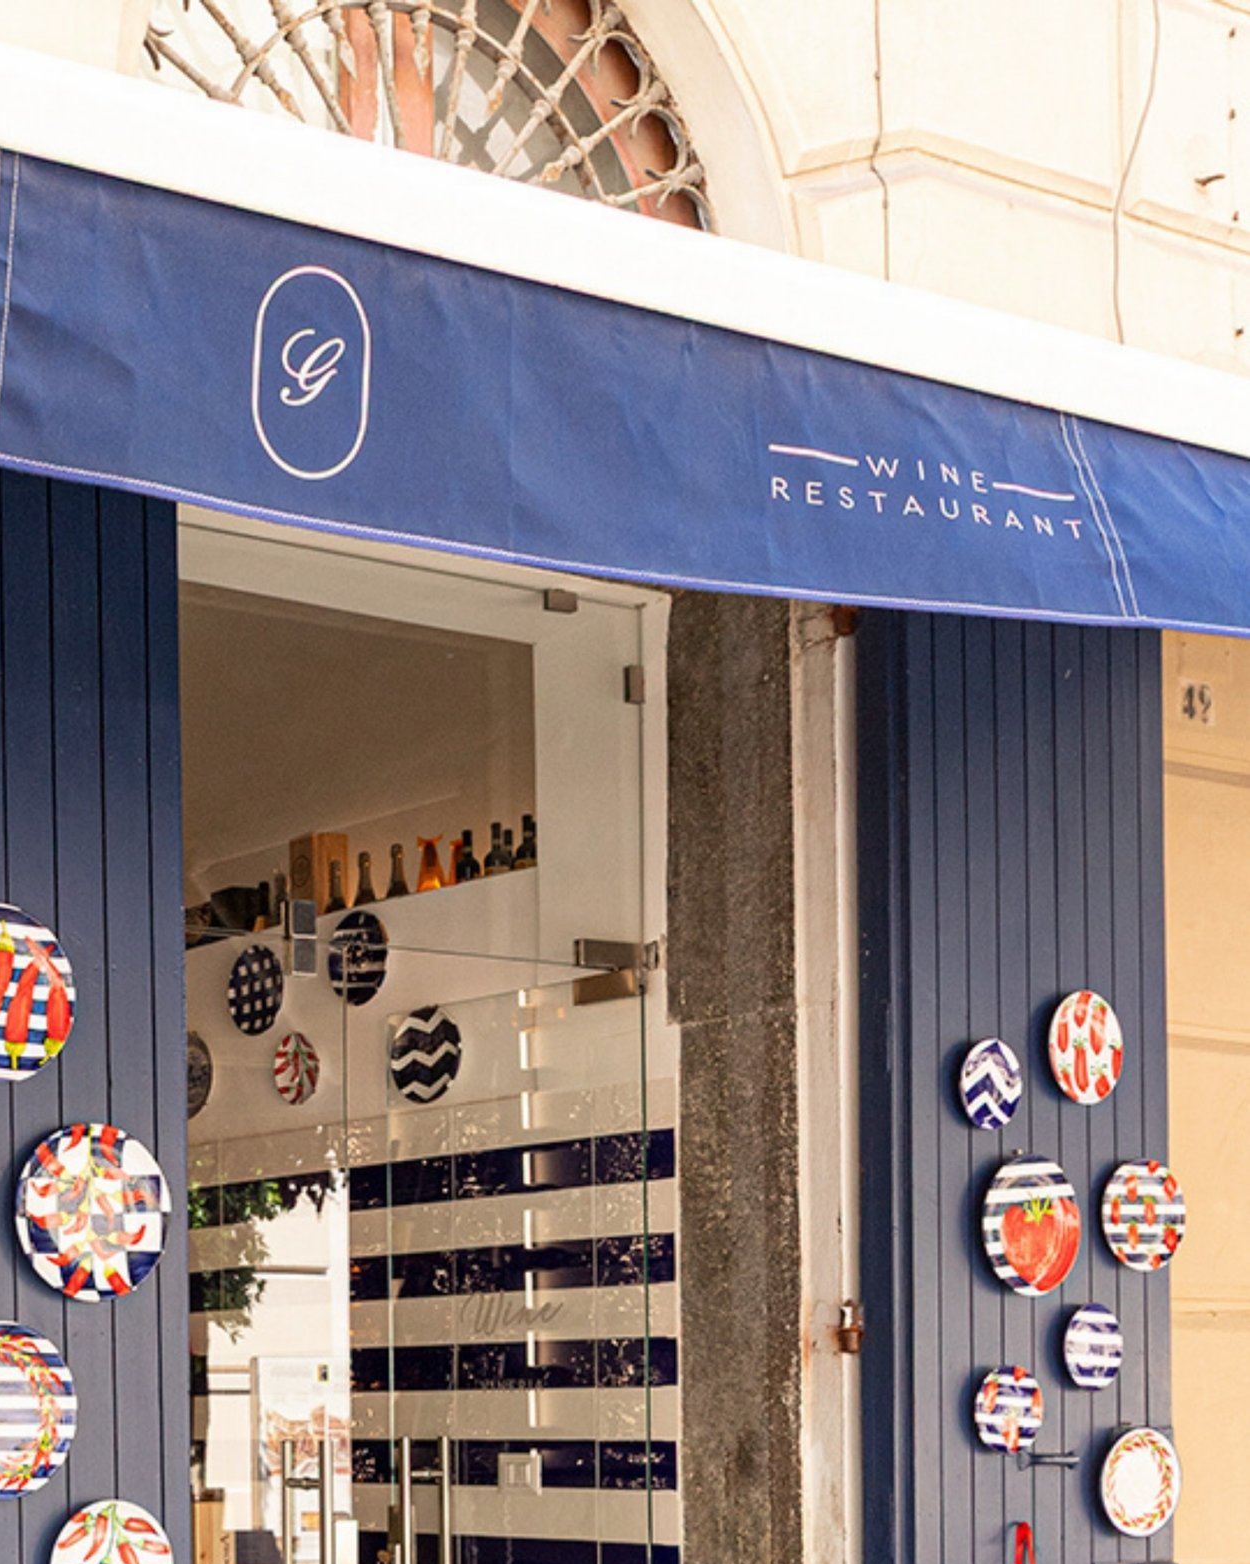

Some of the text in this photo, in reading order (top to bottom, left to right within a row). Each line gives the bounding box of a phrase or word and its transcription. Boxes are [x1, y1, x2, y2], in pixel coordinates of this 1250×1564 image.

[279, 328, 345, 407] G
[865, 454, 989, 494] WINE
[770, 476, 1083, 539] RESTAURANT
[460, 1290, 564, 1337] Wine
